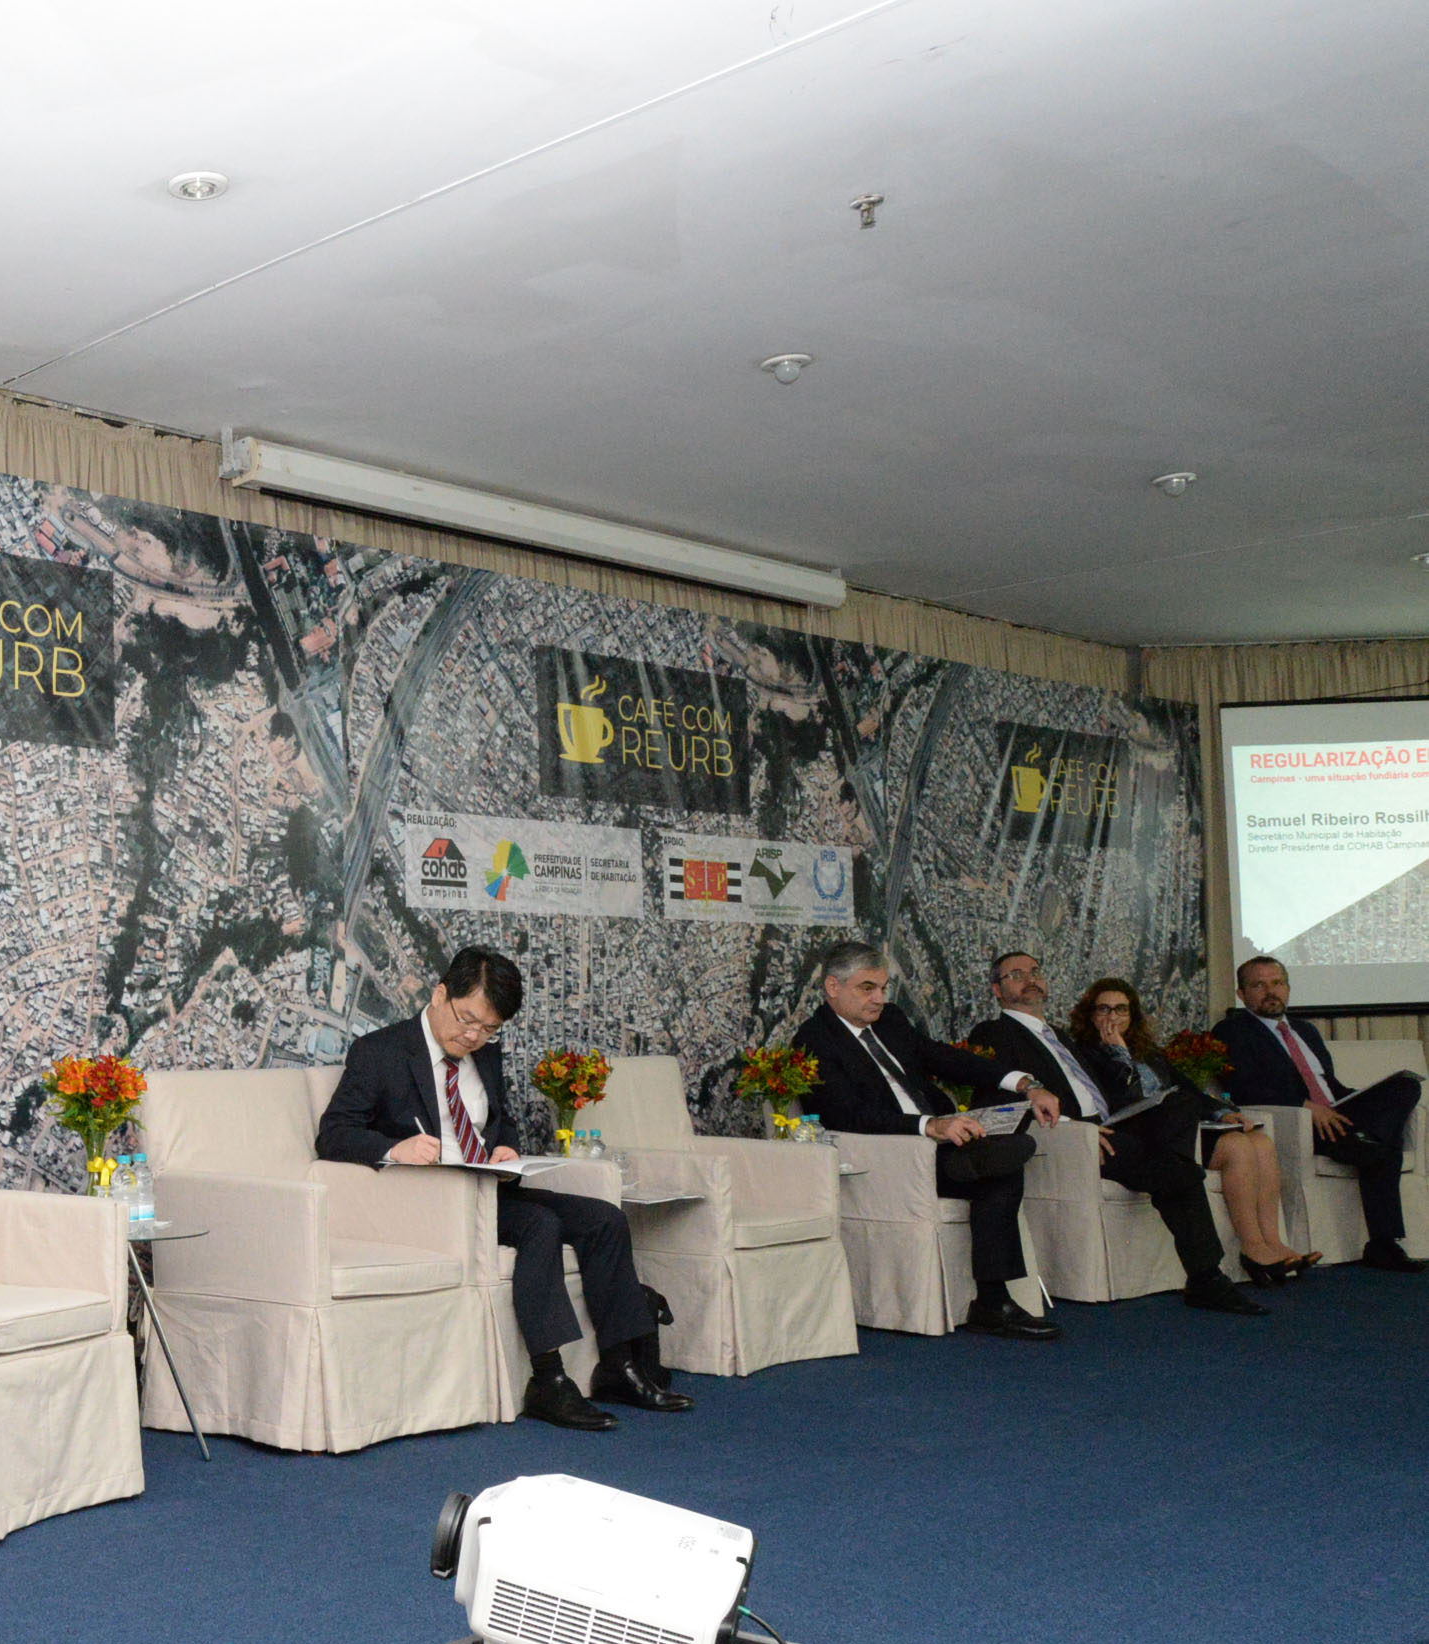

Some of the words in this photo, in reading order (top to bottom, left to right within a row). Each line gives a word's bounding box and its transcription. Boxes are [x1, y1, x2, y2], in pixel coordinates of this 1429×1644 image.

[0, 599, 84, 643] COM
[618, 695, 676, 728] CAFÉ
[682, 704, 732, 735] COM
[621, 726, 734, 777] REURB
[1250, 746, 1411, 770] REGULARIZAÇÃO
[1050, 755, 1084, 781] CAFÉ
[1250, 775, 1296, 784] Campinas
[1328, 770, 1367, 784] situação
[406, 813, 457, 829] REALIZAÇÃO:
[1246, 813, 1306, 828] Samuel
[1312, 812, 1370, 826] Ribeiro
[1375, 808, 1429, 824] Rossilh
[1296, 829, 1340, 841] Municipal
[1343, 830, 1355, 839] de
[1357, 829, 1403, 840] Habitação
[755, 847, 783, 859] ARISP
[1248, 843, 1278, 853] Diretor
[1281, 841, 1330, 852] Presidente
[1347, 840, 1384, 850] COHAB
[533, 853, 571, 865] PREFEITURA
[573, 855, 582, 866] DE
[590, 858, 630, 869] SECRETARIA
[420, 856, 467, 879] cohab
[533, 865, 582, 880] CAMPINAS
[590, 872, 600, 881] DE
[601, 872, 637, 883] HABITAÇÃO
[421, 886, 467, 898] Campinas
